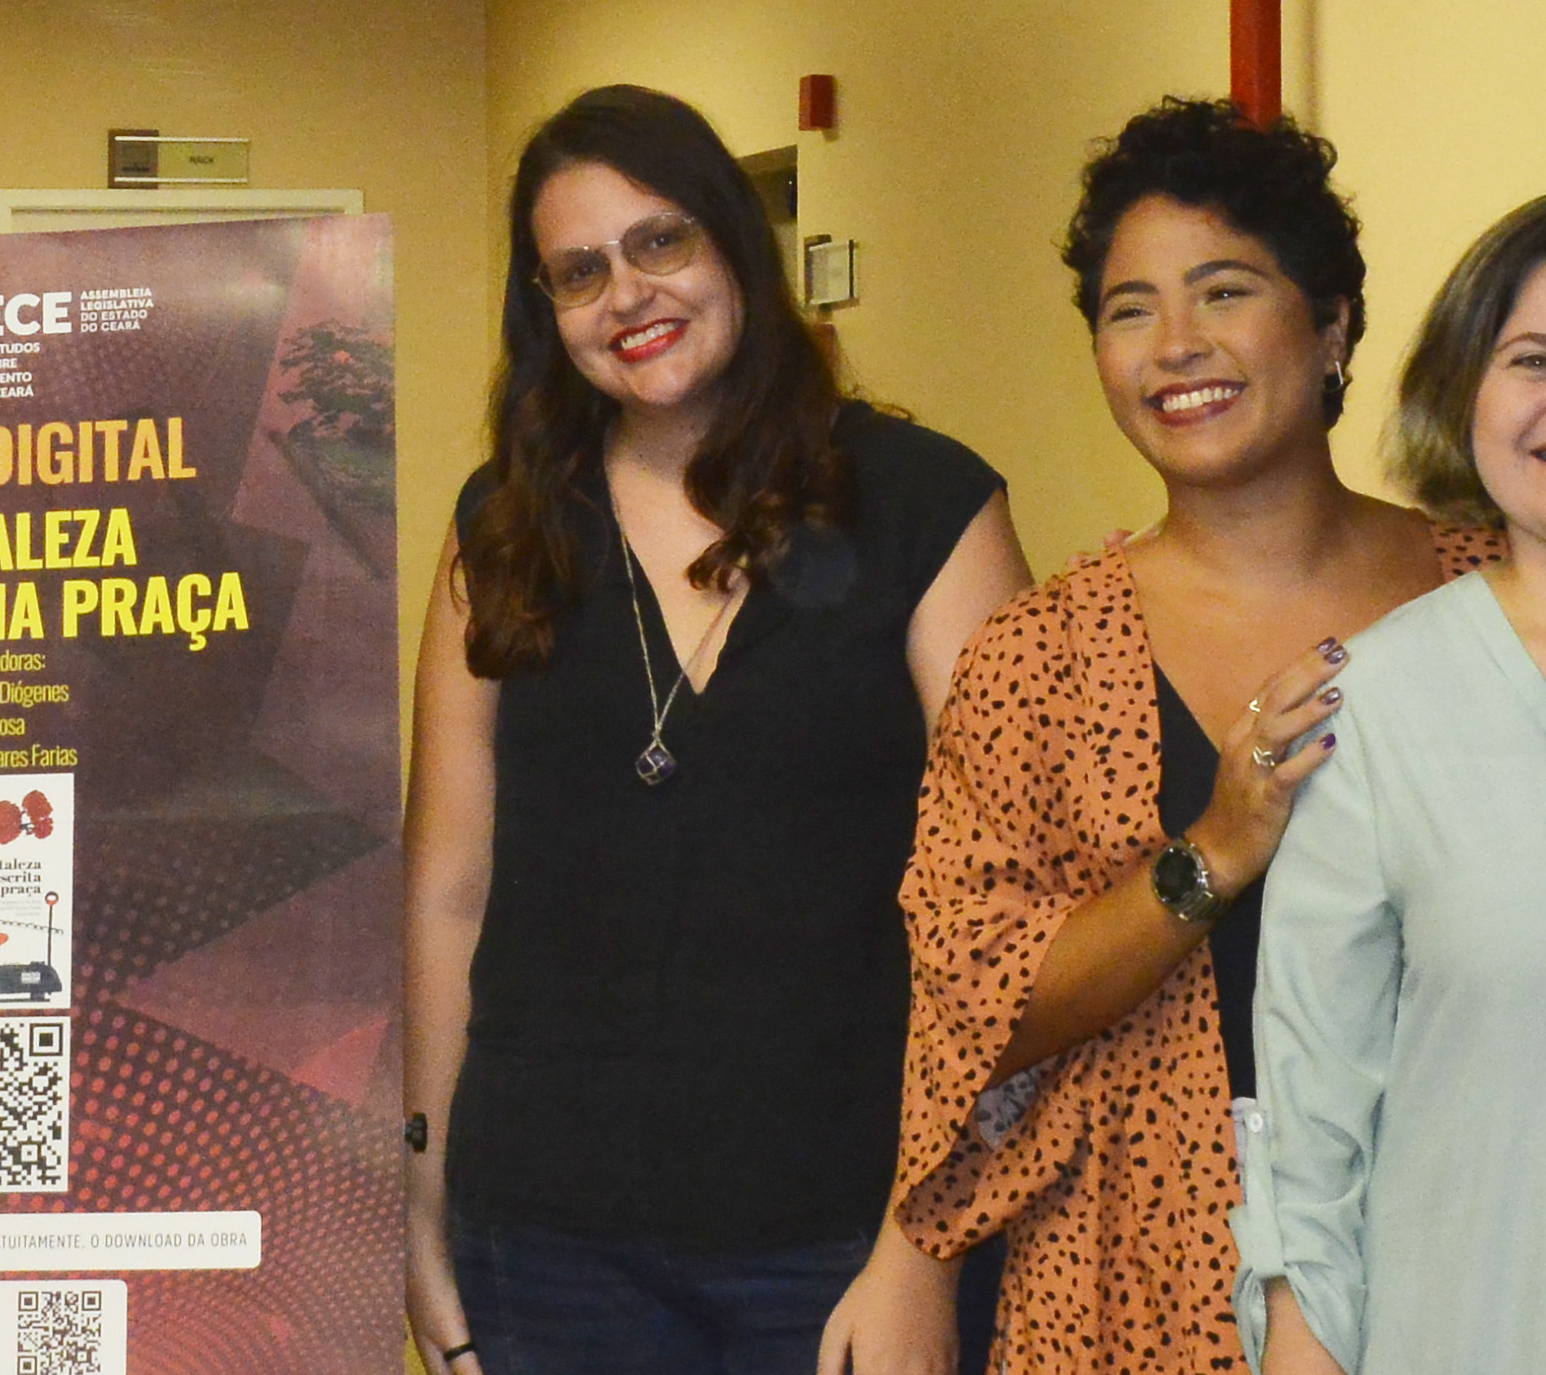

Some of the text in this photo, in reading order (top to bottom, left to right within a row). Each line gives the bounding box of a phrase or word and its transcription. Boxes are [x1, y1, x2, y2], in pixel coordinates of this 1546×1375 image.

[80, 288, 152, 300] ASSEMBLEIA
[80, 298, 154, 311] LEGISLATIVA
[80, 309, 148, 321] DO ESTADO
[80, 319, 141, 333] DO CEARÁ
[62, 572, 249, 651] PRAÇA
[31, 744, 78, 767] Farias
[1, 885, 41, 897] praça
[91, 1234, 99, 1248] O
[105, 1233, 182, 1248] DOWNLOAD
[188, 1233, 205, 1247] DA
[210, 1232, 247, 1247] OBRA
